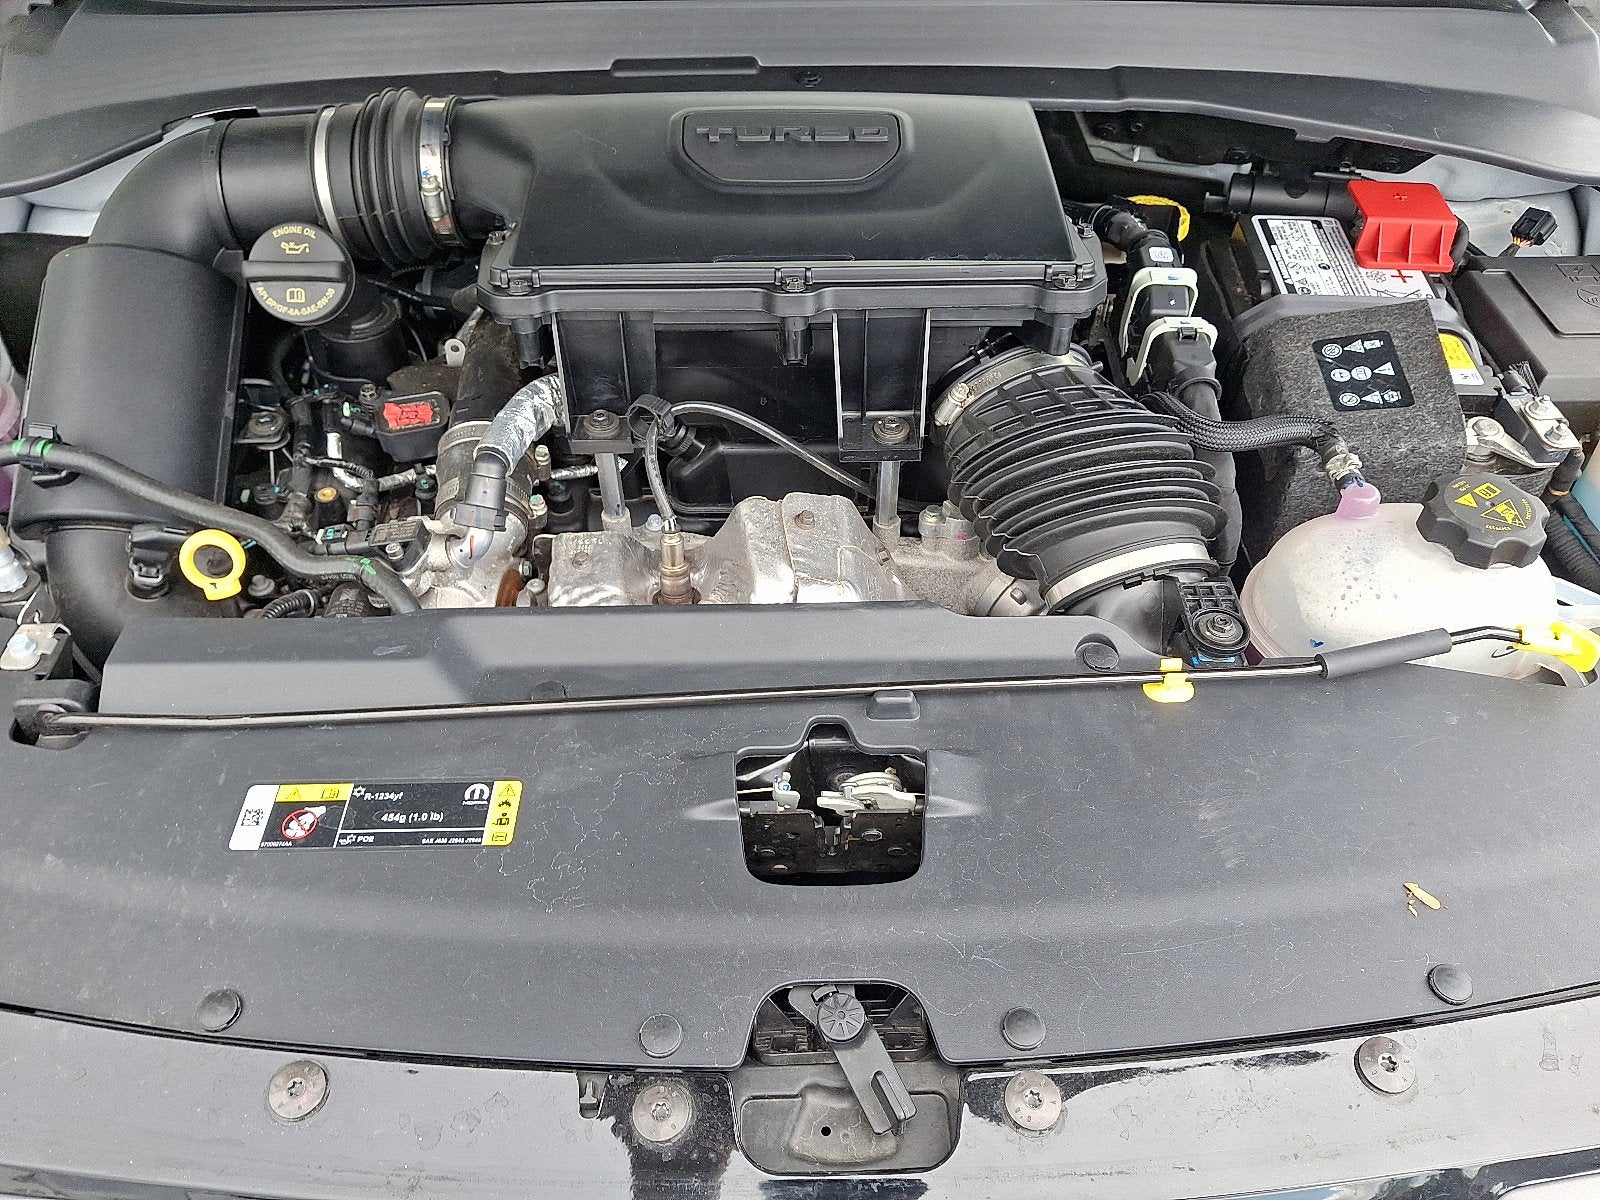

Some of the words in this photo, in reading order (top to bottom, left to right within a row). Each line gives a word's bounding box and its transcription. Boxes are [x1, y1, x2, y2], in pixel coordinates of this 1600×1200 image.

[696, 126, 889, 142] TURBO
[272, 226, 303, 238] ENGINE
[303, 227, 317, 239] OIL
[364, 792, 404, 802] R-1234yf
[381, 812, 406, 823] 454g
